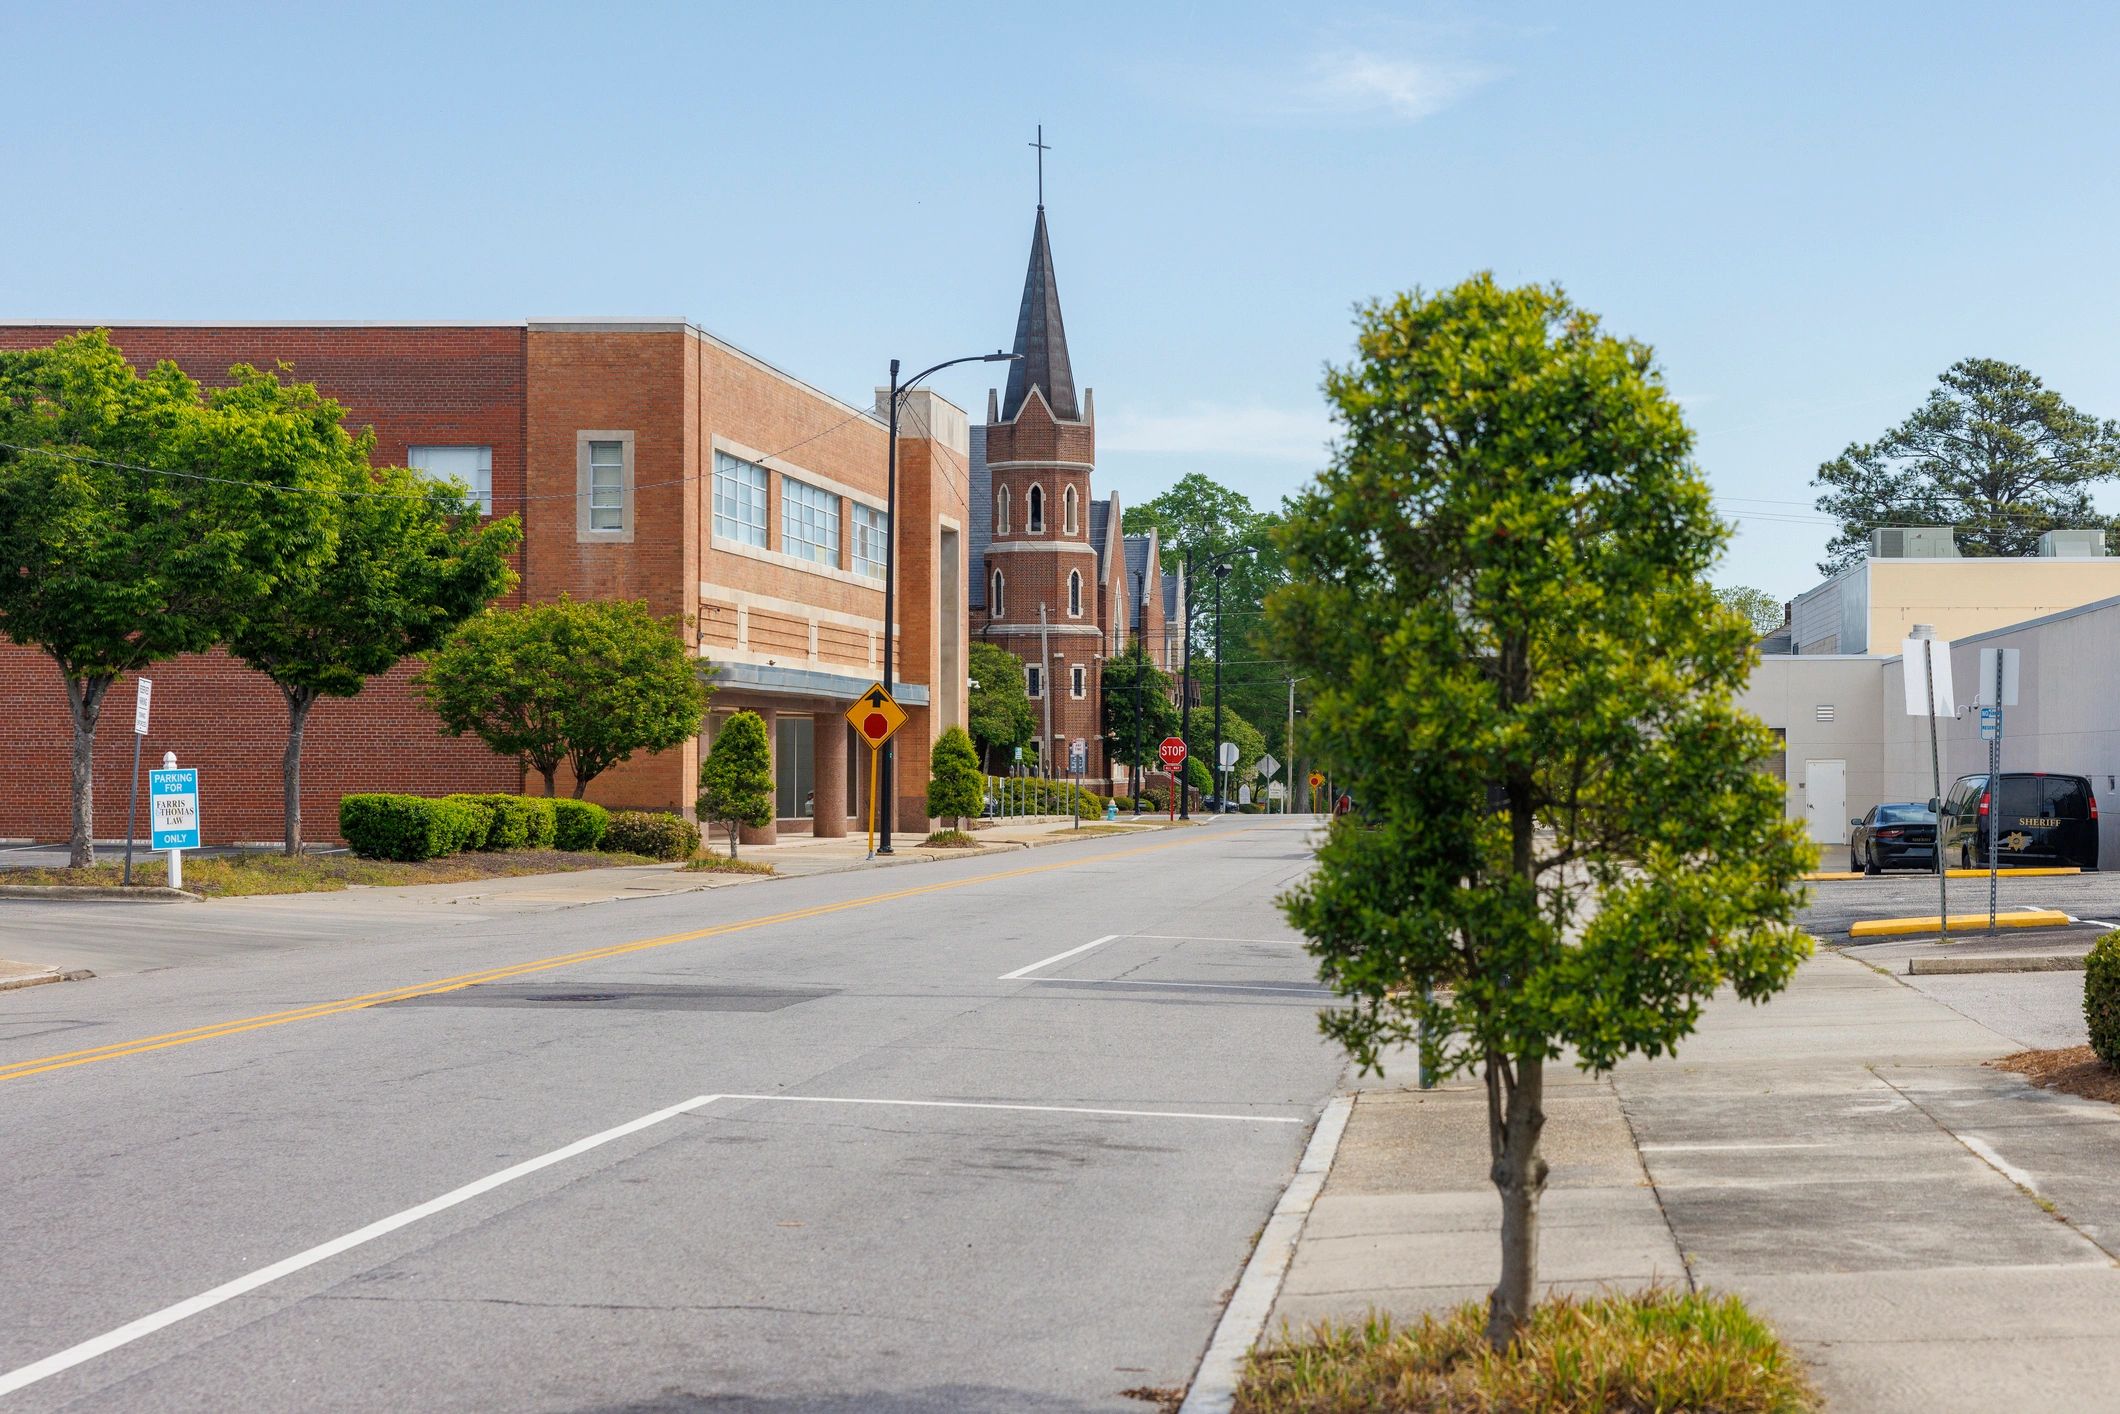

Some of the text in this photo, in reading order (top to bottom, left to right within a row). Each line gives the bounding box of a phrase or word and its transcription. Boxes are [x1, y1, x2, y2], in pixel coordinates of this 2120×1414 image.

[1161, 745, 1185, 756] STOP
[154, 773, 193, 784] PARKING
[164, 783, 183, 793] FOR
[156, 799, 186, 809] FARRIS
[166, 817, 184, 825] LAW
[2019, 817, 2061, 827] SHERIFF
[163, 833, 187, 844] ONLY
